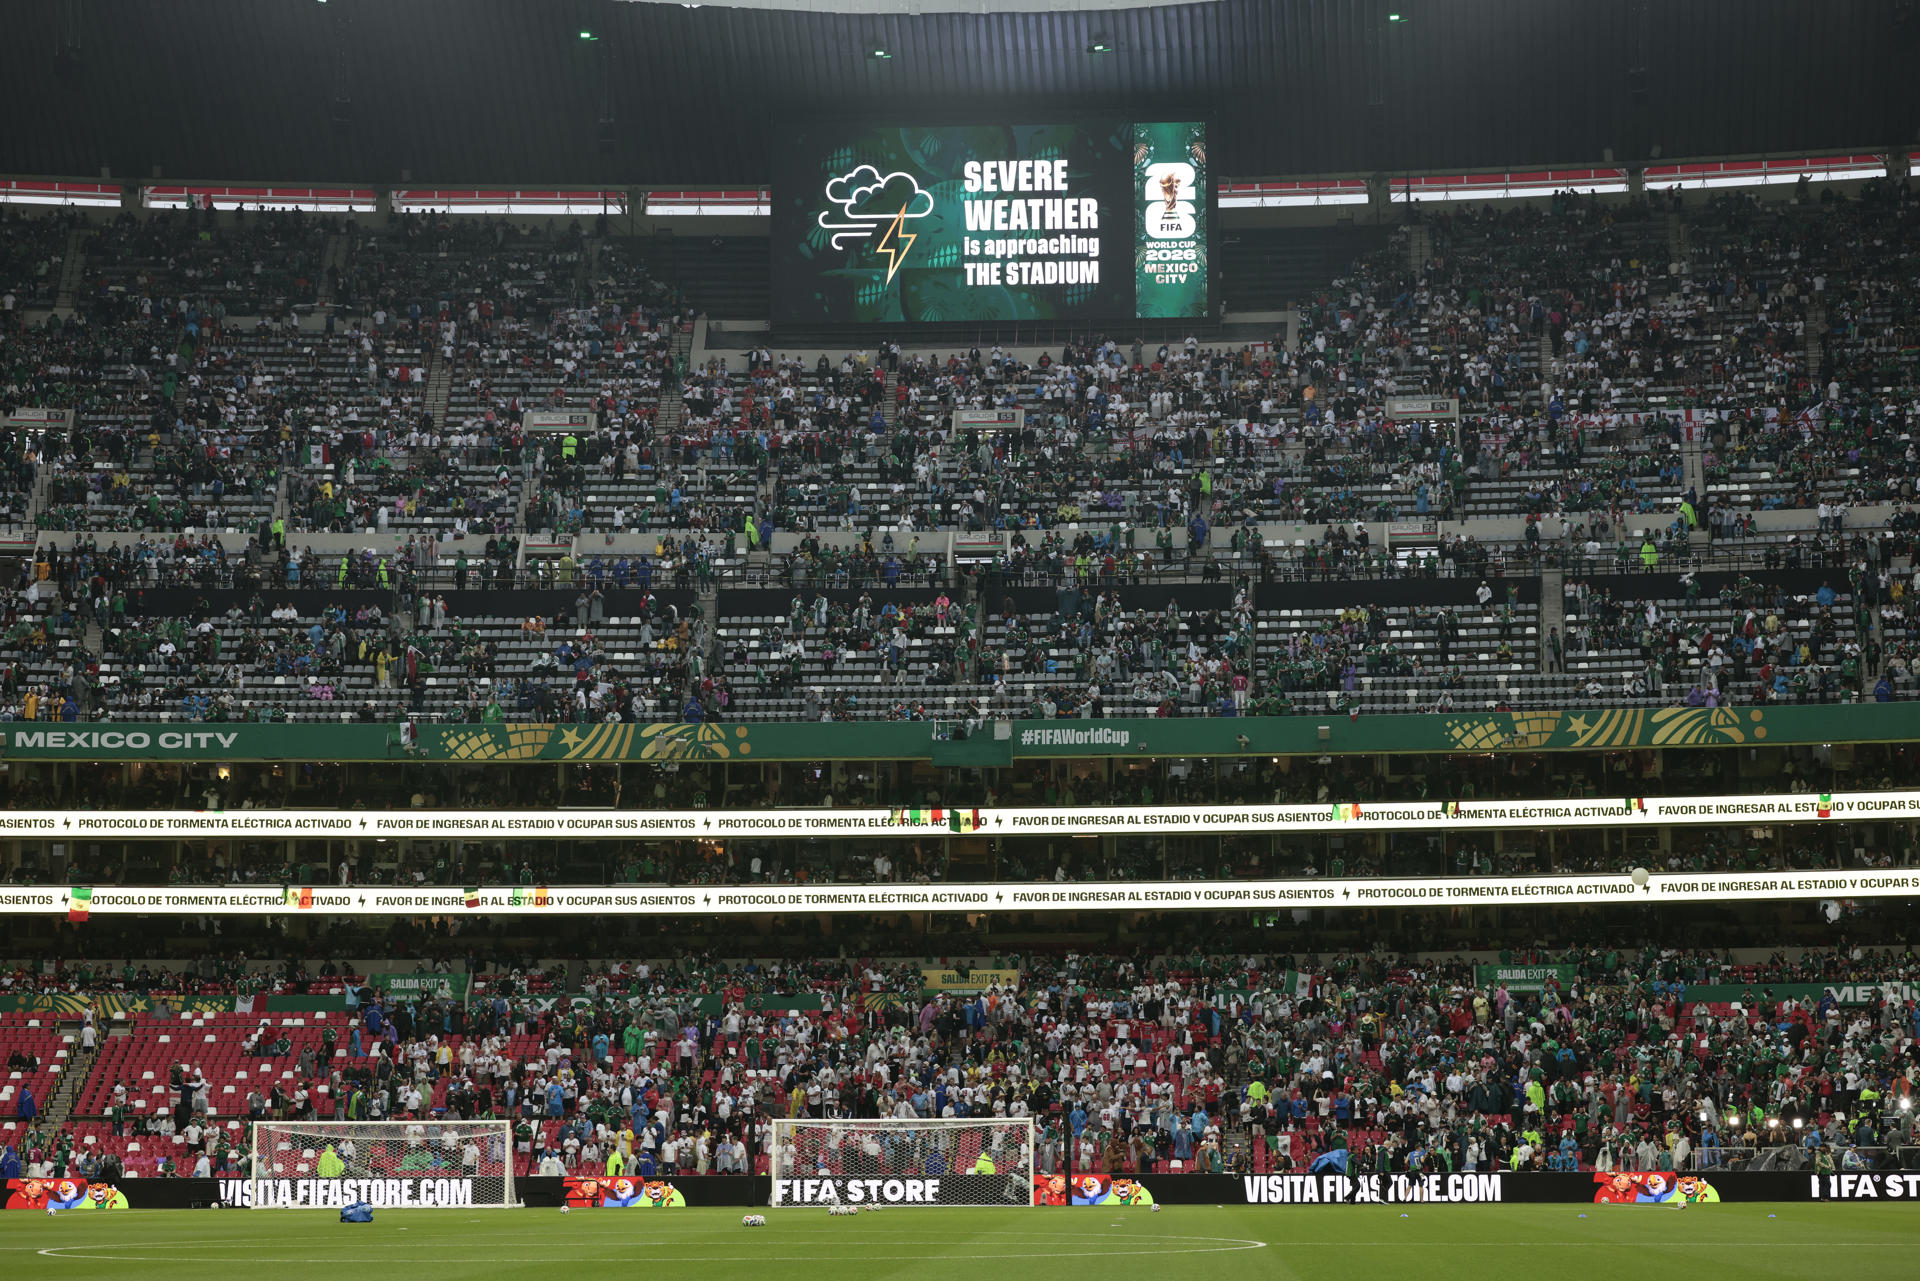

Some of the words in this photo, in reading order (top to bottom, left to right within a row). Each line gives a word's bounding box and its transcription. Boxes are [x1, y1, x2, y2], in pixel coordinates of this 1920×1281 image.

[964, 159, 1068, 192] SEVERE
[964, 198, 1099, 231] WEATHER
[1160, 223, 1183, 231] FIFA
[964, 236, 981, 256] is
[984, 234, 1100, 258] approaching
[1146, 249, 1197, 261] 2026
[964, 262, 1001, 285] THE
[1006, 261, 1100, 285] STADIUM
[1145, 262, 1198, 273] MEXICO
[1155, 274, 1187, 284] CITY
[15, 732, 150, 748] MEXICO
[159, 733, 238, 748] CITY
[1021, 728, 1129, 746] #FIFAWorldCup
[1357, 810, 1425, 820] PROTOCOLO
[1428, 810, 1442, 820] DE
[1510, 806, 1572, 818] ELÉCTRICA
[1575, 807, 1632, 817] ACTIVADO
[1659, 806, 1697, 815] FAVOR
[1699, 805, 1713, 814] DE
[1716, 803, 1774, 813] INGRESAR
[1778, 803, 1792, 812] AL
[1795, 801, 1845, 811] ESTIO
[1847, 802, 1855, 810] Y
[1858, 801, 1906, 810] OCUPAR
[0, 819, 55, 829] ASIENTOS
[79, 819, 147, 828] PROTOCOLO
[150, 819, 164, 828] DE
[167, 819, 229, 828] TORMENTA
[231, 816, 292, 828] ELÉCTRICA
[295, 819, 352, 828] ACTIVADO
[377, 819, 410, 829] FAVOR
[412, 819, 430, 829] DE
[433, 819, 488, 829] INGRESAR
[491, 819, 506, 829] AL
[508, 819, 555, 829] ESTADIO
[557, 819, 565, 829] Y
[567, 819, 613, 828] OCUPAR
[615, 819, 638, 828] SUS
[641, 819, 696, 828] ASIENTOS
[719, 819, 786, 828] PROTOCOLO
[789, 818, 802, 828] DE
[805, 818, 866, 828] TORMENTA
[1013, 816, 1050, 826] FAVOR
[1052, 816, 1066, 825] DE
[1068, 815, 1125, 825] INGRESAR
[1127, 815, 1142, 825] AL
[1144, 814, 1191, 824] ESTADIO
[1193, 815, 1201, 823] Y
[1203, 813, 1250, 823] OCUPAR
[1252, 812, 1275, 822] SUS
[1277, 811, 1333, 822] ASIENTOS
[1358, 888, 1427, 898] PROTOCOLO
[1429, 887, 1444, 897] DE
[1446, 886, 1509, 897] TORMENTA
[1512, 884, 1574, 896] ELÉCTRICA
[1577, 884, 1635, 894] ACTIVADO
[1661, 883, 1699, 893] FAVOR
[1702, 882, 1716, 892] DE
[1719, 880, 1778, 891] INGRESAR
[1781, 880, 1795, 890] AL
[1798, 879, 1848, 890] ESTADIO
[1850, 879, 1858, 889] Y
[1861, 878, 1909, 889] OCUPAR
[89, 895, 146, 905] OTOCOLO
[148, 895, 162, 905] DE
[165, 896, 228, 905] TORMENTA
[376, 896, 413, 906] FAVOR
[415, 896, 429, 906] DE
[432, 896, 489, 906] INGRER
[491, 896, 505, 906] AL
[508, 896, 554, 906] ESTADIO
[557, 896, 564, 906] Y
[567, 896, 613, 906] OCUPAR
[615, 896, 638, 905] SUS
[640, 896, 696, 905] ASIENTOS
[719, 895, 786, 905] PROTOCOLO
[789, 895, 803, 904] DE
[805, 894, 866, 904] TORMENTA
[869, 891, 929, 904] ELÉCTRICA
[931, 893, 988, 903] ACTIVADO
[1014, 893, 1050, 902] FAVOR
[1053, 892, 1067, 902] DE
[1069, 892, 1126, 902] INGRESAR
[1128, 891, 1143, 901] AL
[1145, 890, 1192, 901] ESTADIO
[1195, 891, 1202, 900] Y
[1204, 890, 1251, 900] OCUPAR
[1253, 890, 1276, 900] SUS
[1279, 889, 1335, 899] ASIENTOS
[971, 974, 988, 984] EXIT
[1496, 969, 1527, 980] SALIDA
[1527, 969, 1546, 979] EXIT
[1547, 968, 1558, 979] 22
[390, 978, 420, 989] SALIDA
[420, 978, 438, 988] EXIT
[219, 1179, 292, 1207] VISITA
[297, 1179, 472, 1206] FIFASTORE.COM
[1244, 1175, 1320, 1203] VISITA
